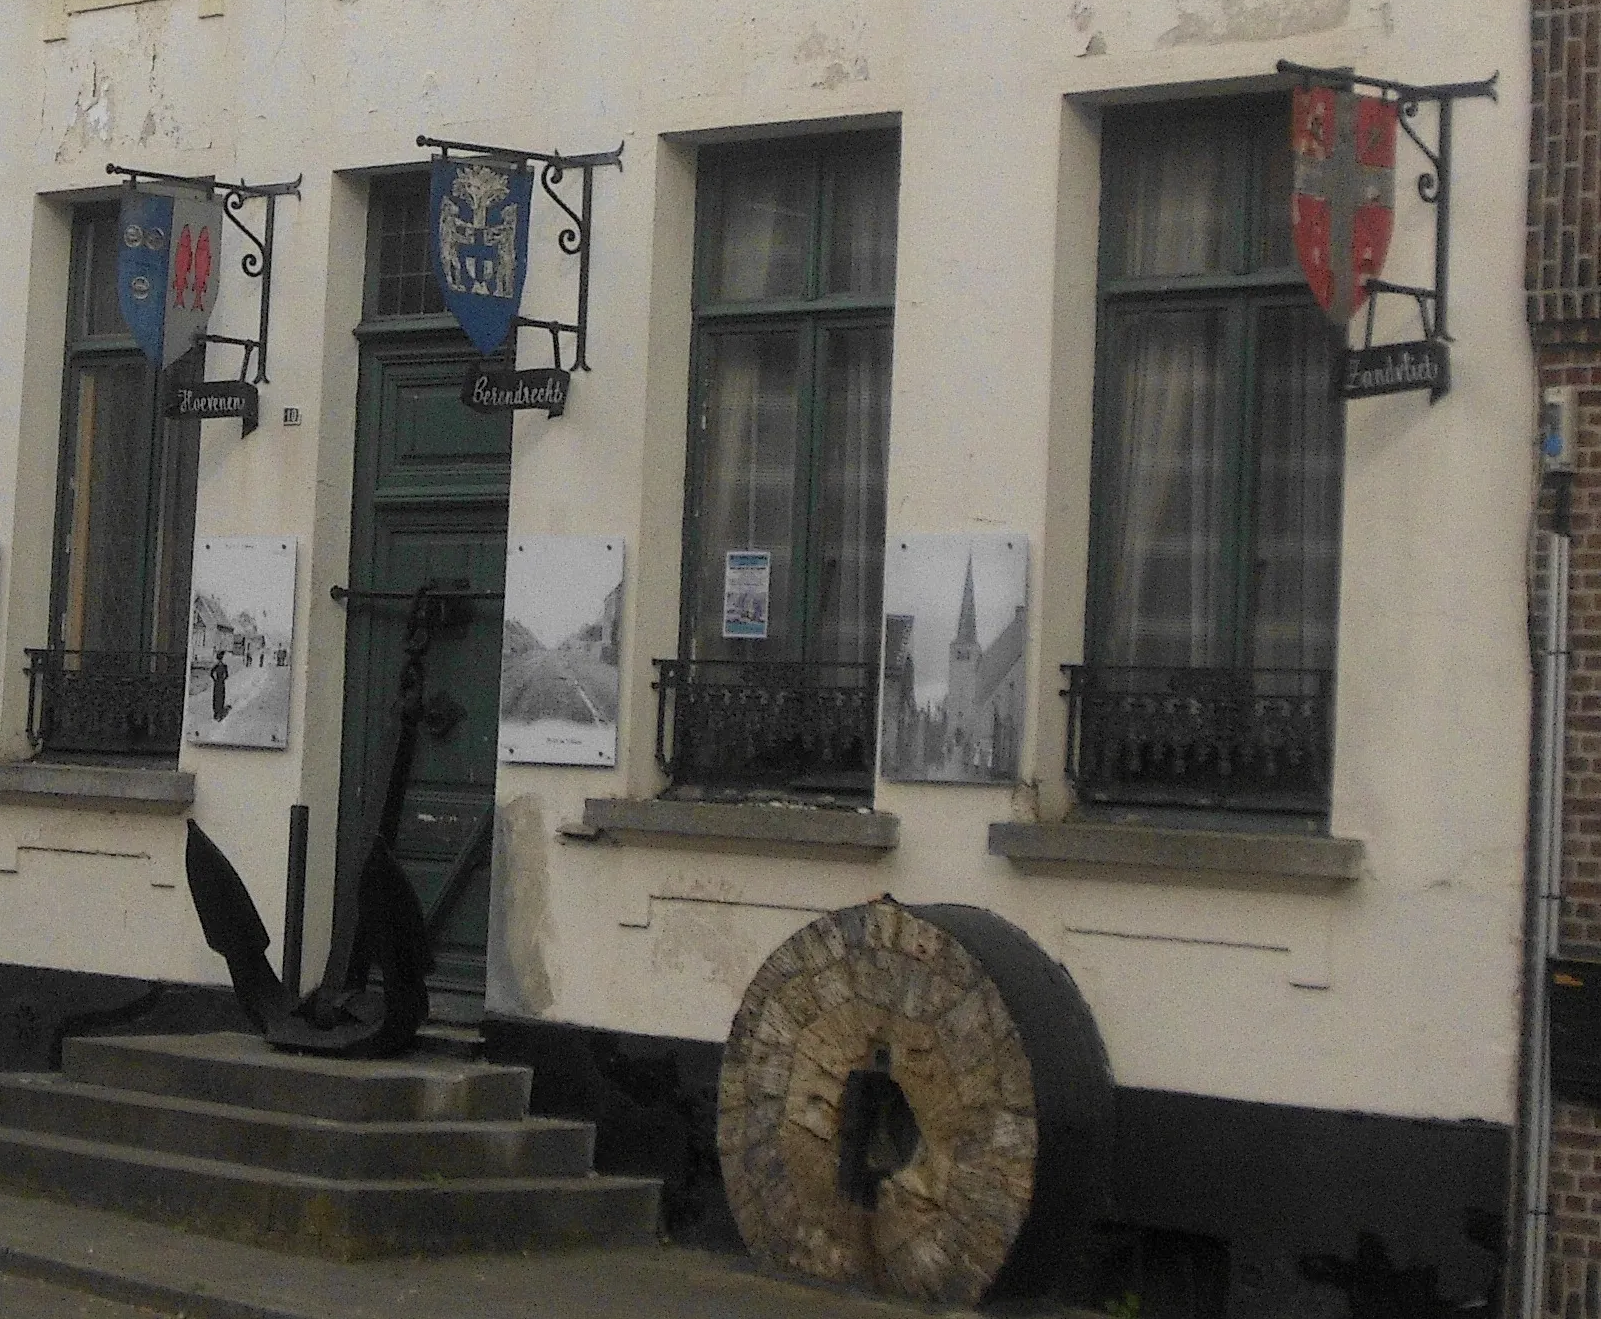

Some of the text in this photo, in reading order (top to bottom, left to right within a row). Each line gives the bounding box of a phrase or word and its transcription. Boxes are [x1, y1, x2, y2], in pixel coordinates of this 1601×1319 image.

[1344, 351, 1438, 389] Zandvliet
[177, 389, 245, 413] Hoevenen
[472, 375, 563, 406] Berendrecht
